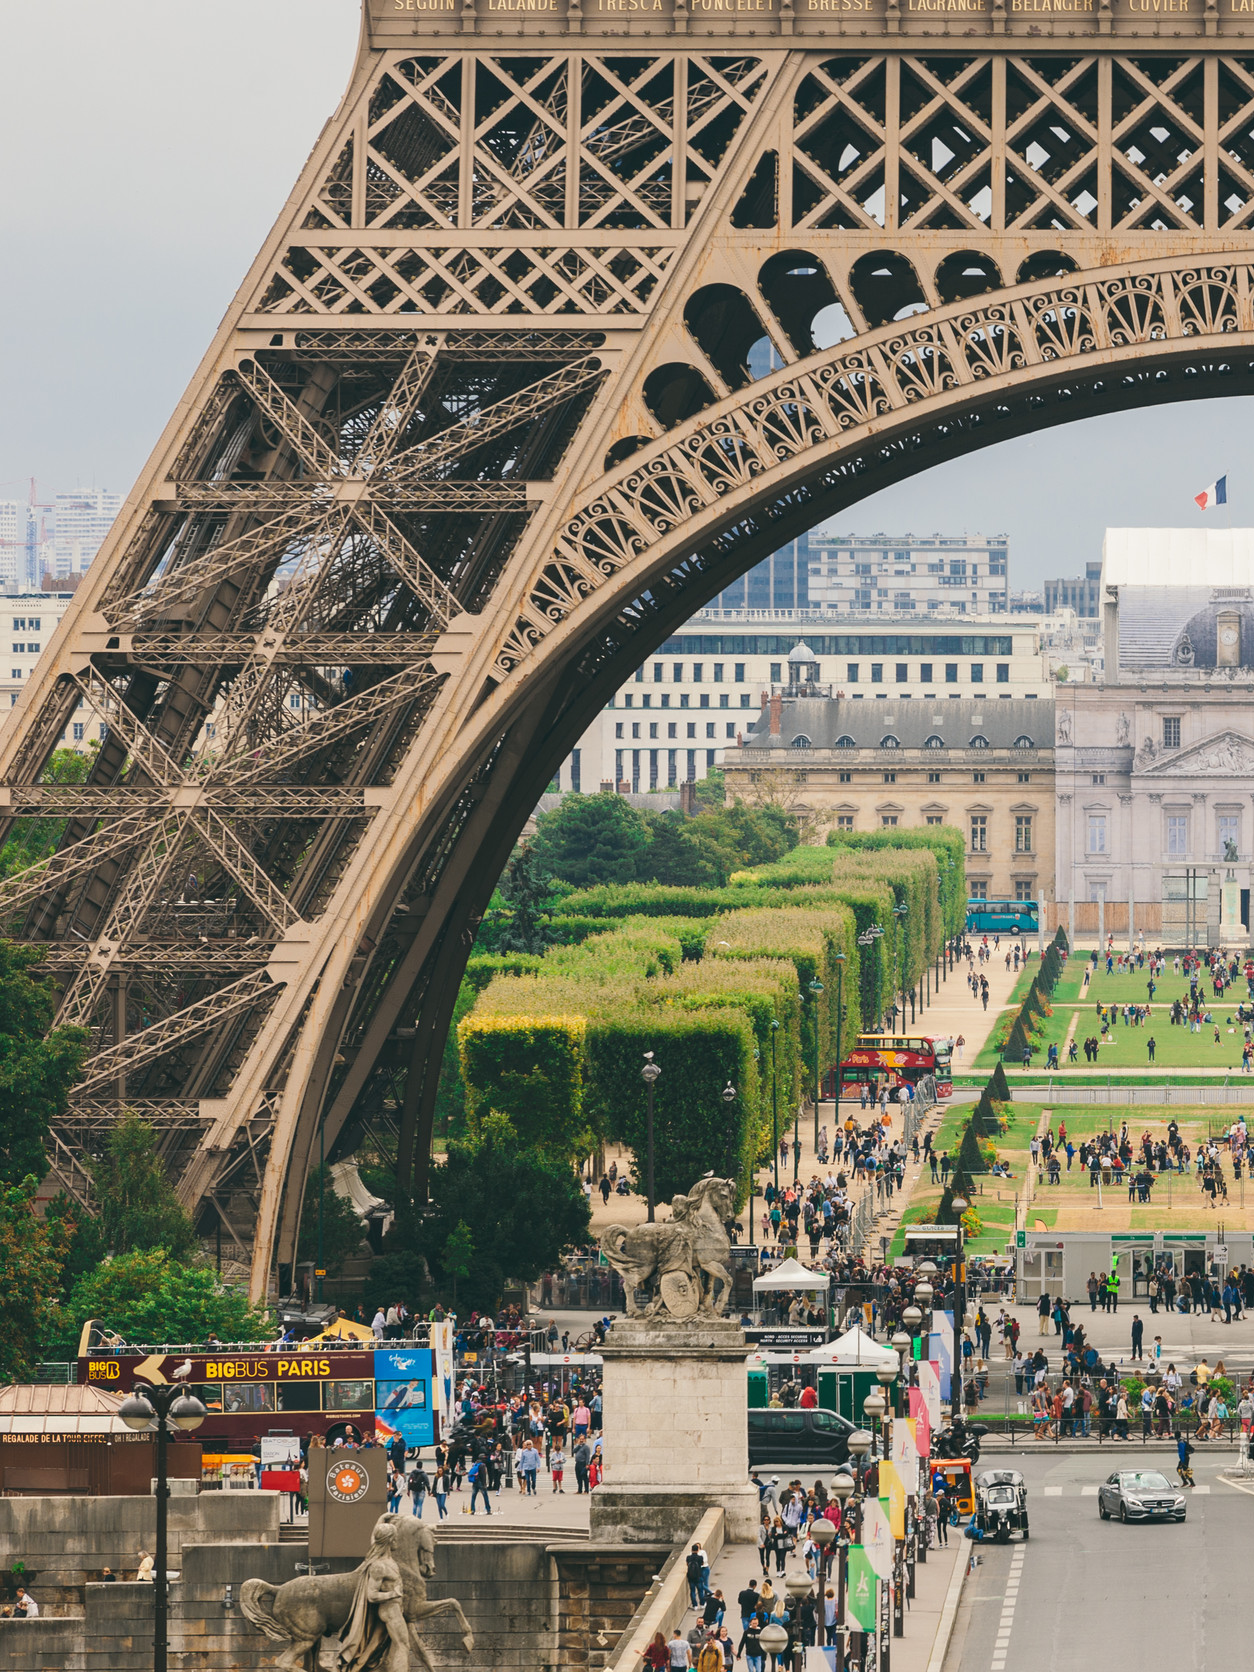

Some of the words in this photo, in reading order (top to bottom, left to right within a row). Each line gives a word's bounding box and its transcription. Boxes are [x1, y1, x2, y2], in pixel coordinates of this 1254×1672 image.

[394, 0, 455, 11] SEGUIN
[489, 0, 558, 11] LALANDE
[808, 0, 874, 11] BRESSE
[909, 0, 986, 11] LAGRANGE
[1012, 0, 1093, 12] BELANGER
[1129, 0, 1189, 12] CUVIER
[89, 1362, 106, 1371] BIG
[278, 1360, 331, 1376] PARIS
[89, 1371, 106, 1379] BUS
[3, 1434, 39, 1443] REGALADE
[41, 1434, 51, 1443] DE
[52, 1434, 62, 1443] LA
[330, 1463, 365, 1479] Bateaux
[330, 1484, 366, 1501] Parisiens
